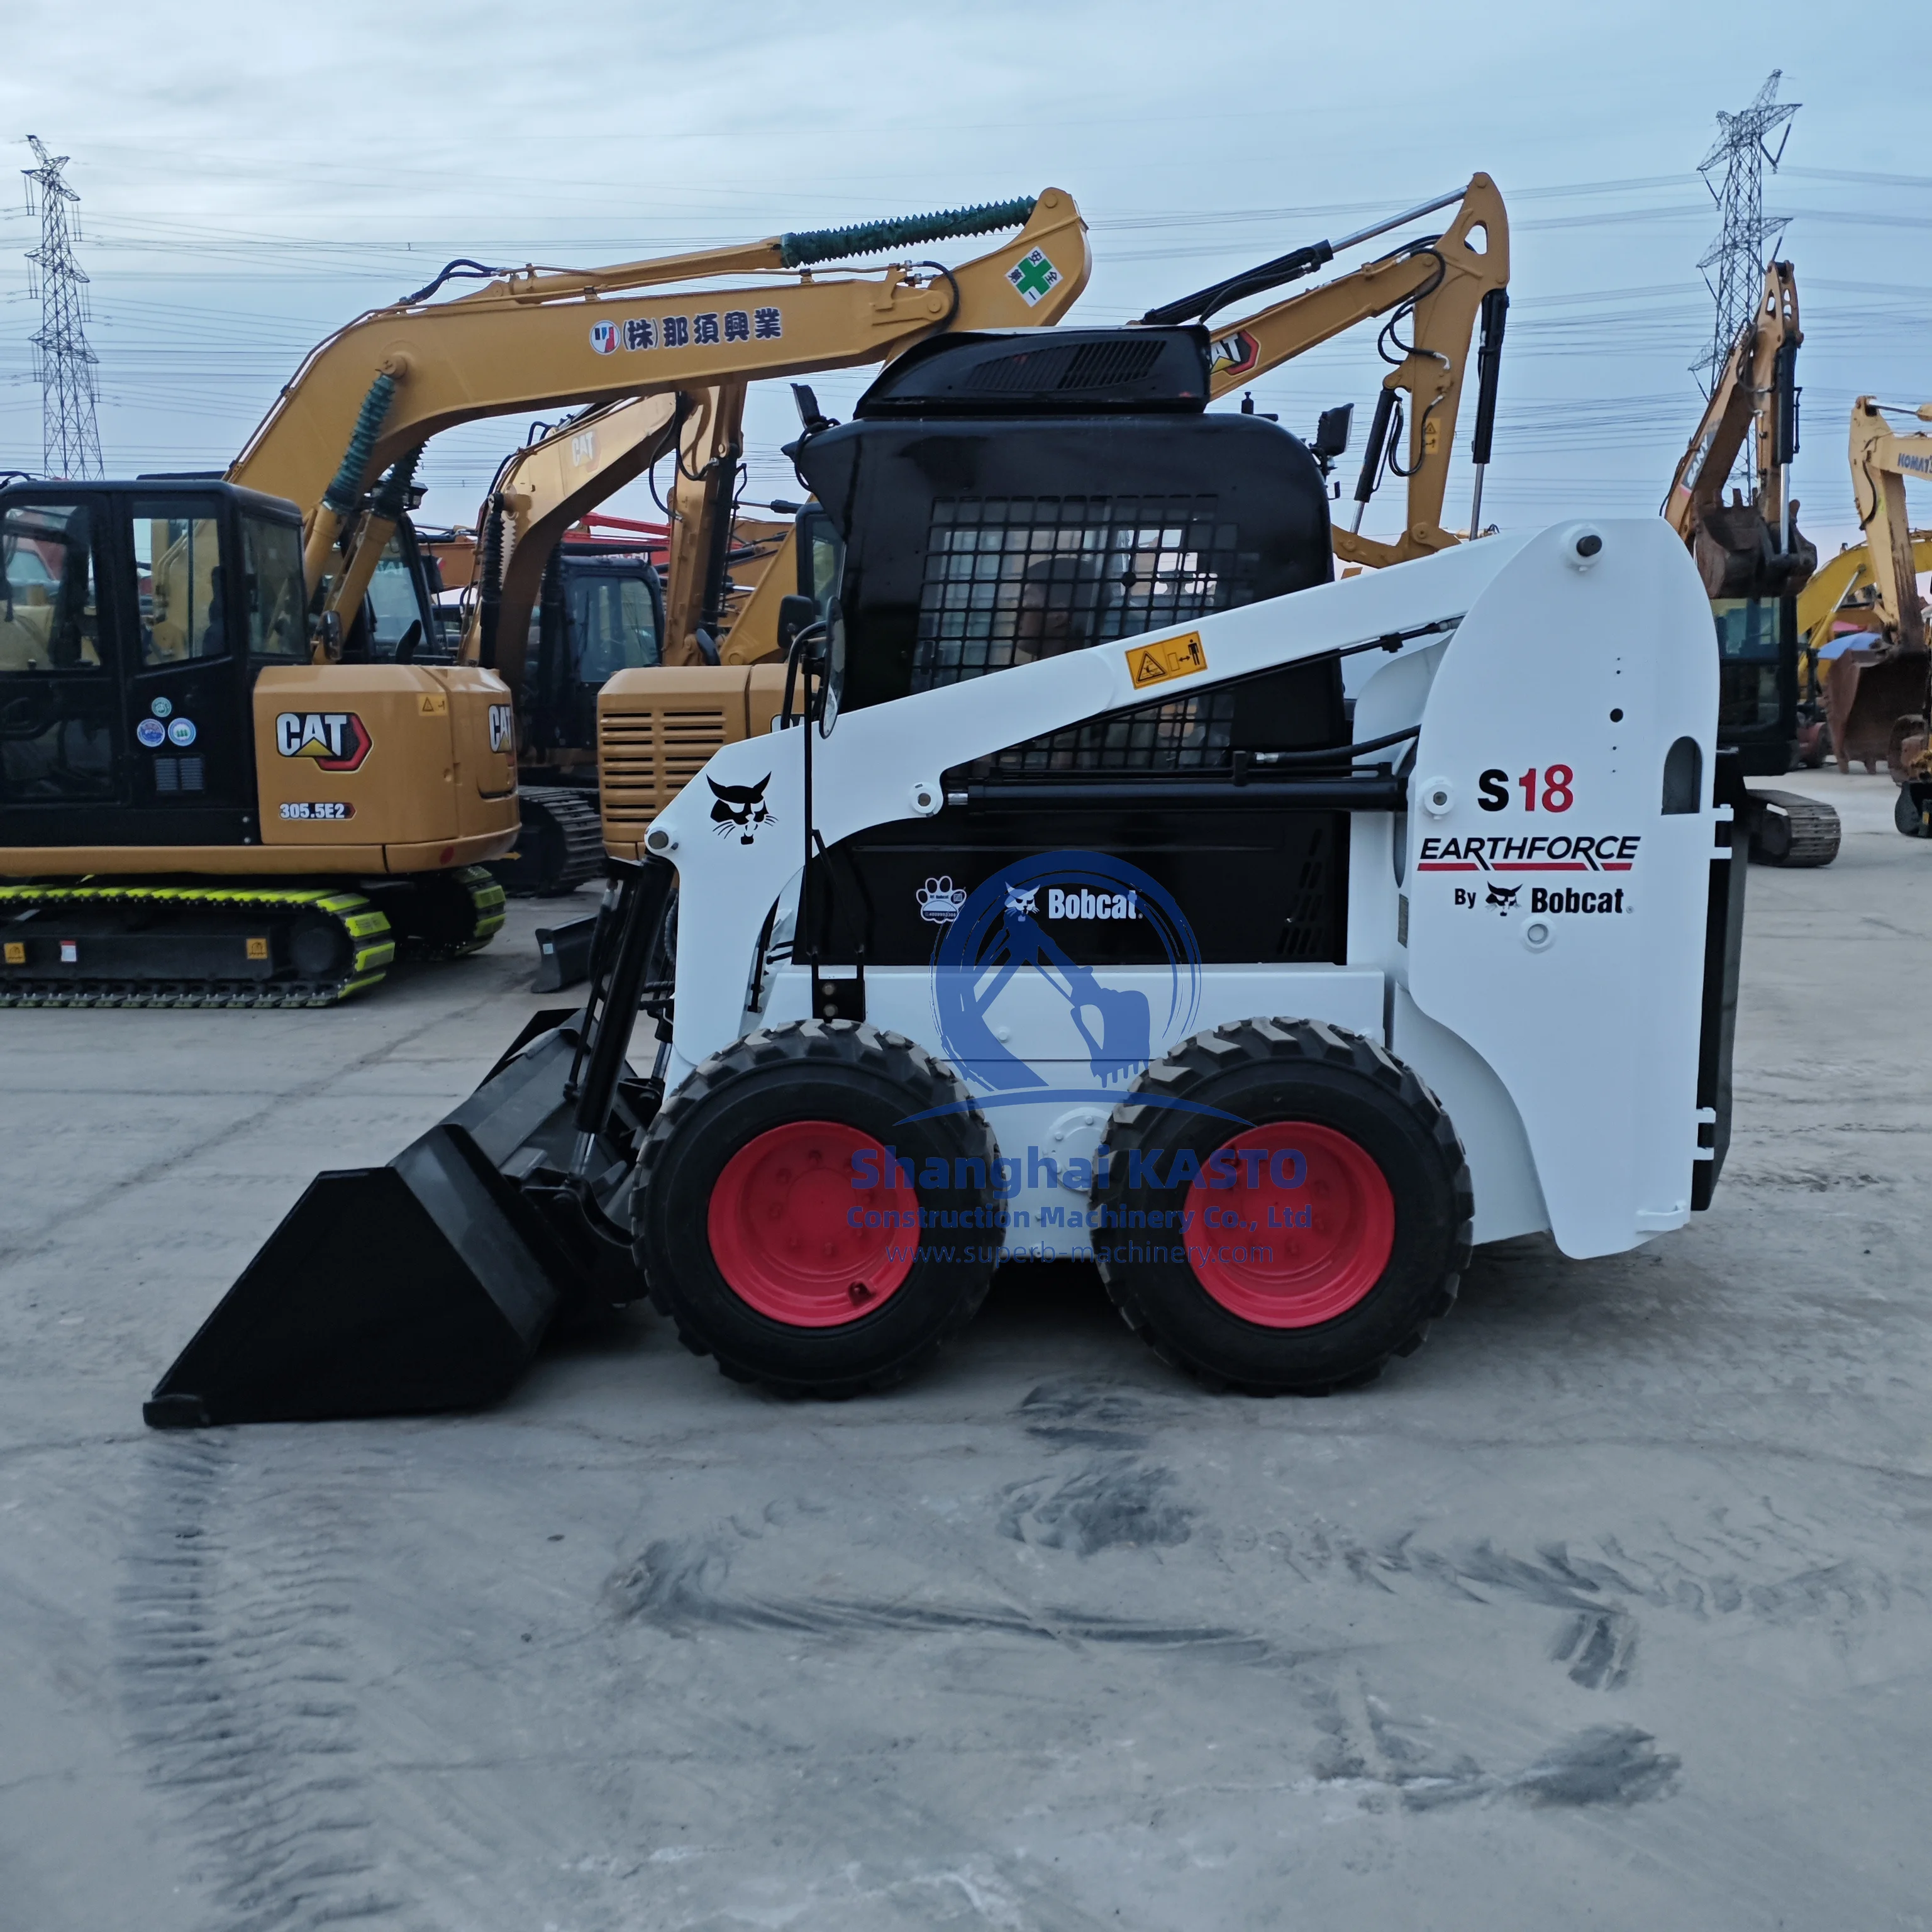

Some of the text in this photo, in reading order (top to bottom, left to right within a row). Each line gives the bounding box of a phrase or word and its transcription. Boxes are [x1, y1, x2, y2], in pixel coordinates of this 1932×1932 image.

[1209, 333, 1241, 369] AT
[572, 431, 593, 467] CAT
[1687, 433, 1708, 487] SANY
[276, 713, 348, 757] CAT
[489, 705, 512, 752] CAT
[279, 803, 345, 819] 305.5E2
[1419, 835, 1642, 872] EARTHFORCE
[1048, 888, 1138, 920] Bobcat
[1454, 887, 1624, 914] By Bobcat
